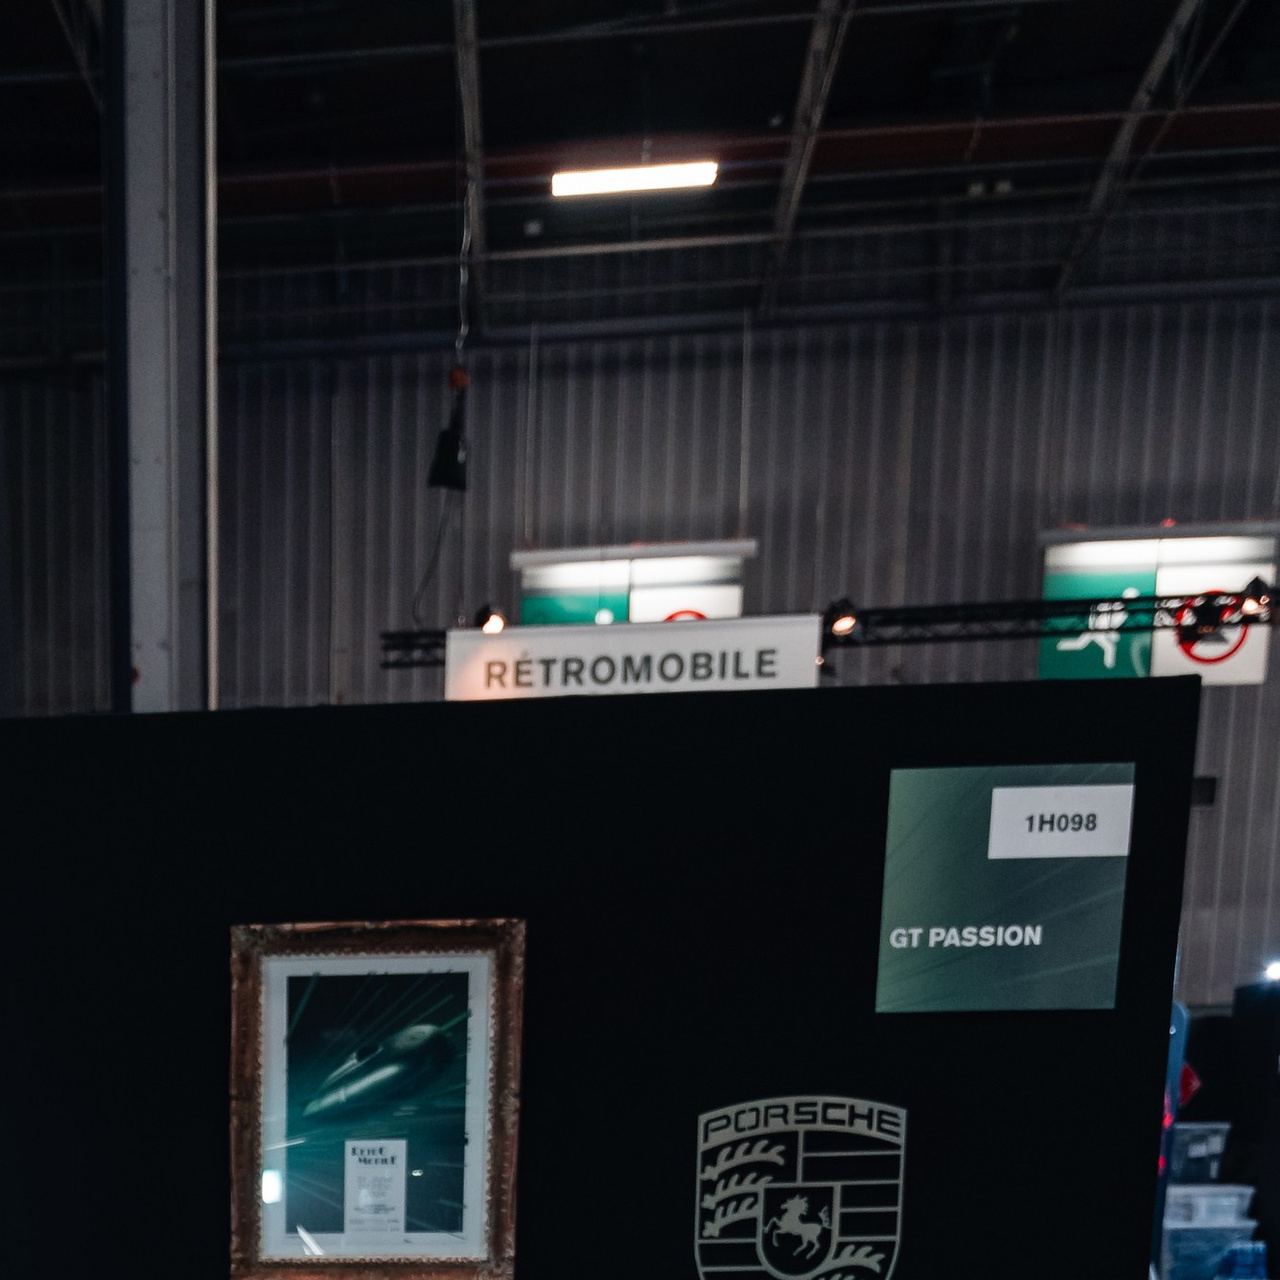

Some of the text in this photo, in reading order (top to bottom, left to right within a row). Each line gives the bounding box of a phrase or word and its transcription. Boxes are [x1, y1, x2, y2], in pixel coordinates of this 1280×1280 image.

[484, 647, 778, 688] RÉTROMOBILE
[1026, 813, 1097, 833] 1H098
[889, 925, 1042, 949] GT PASSION
[703, 1101, 901, 1144] PORSCHE
